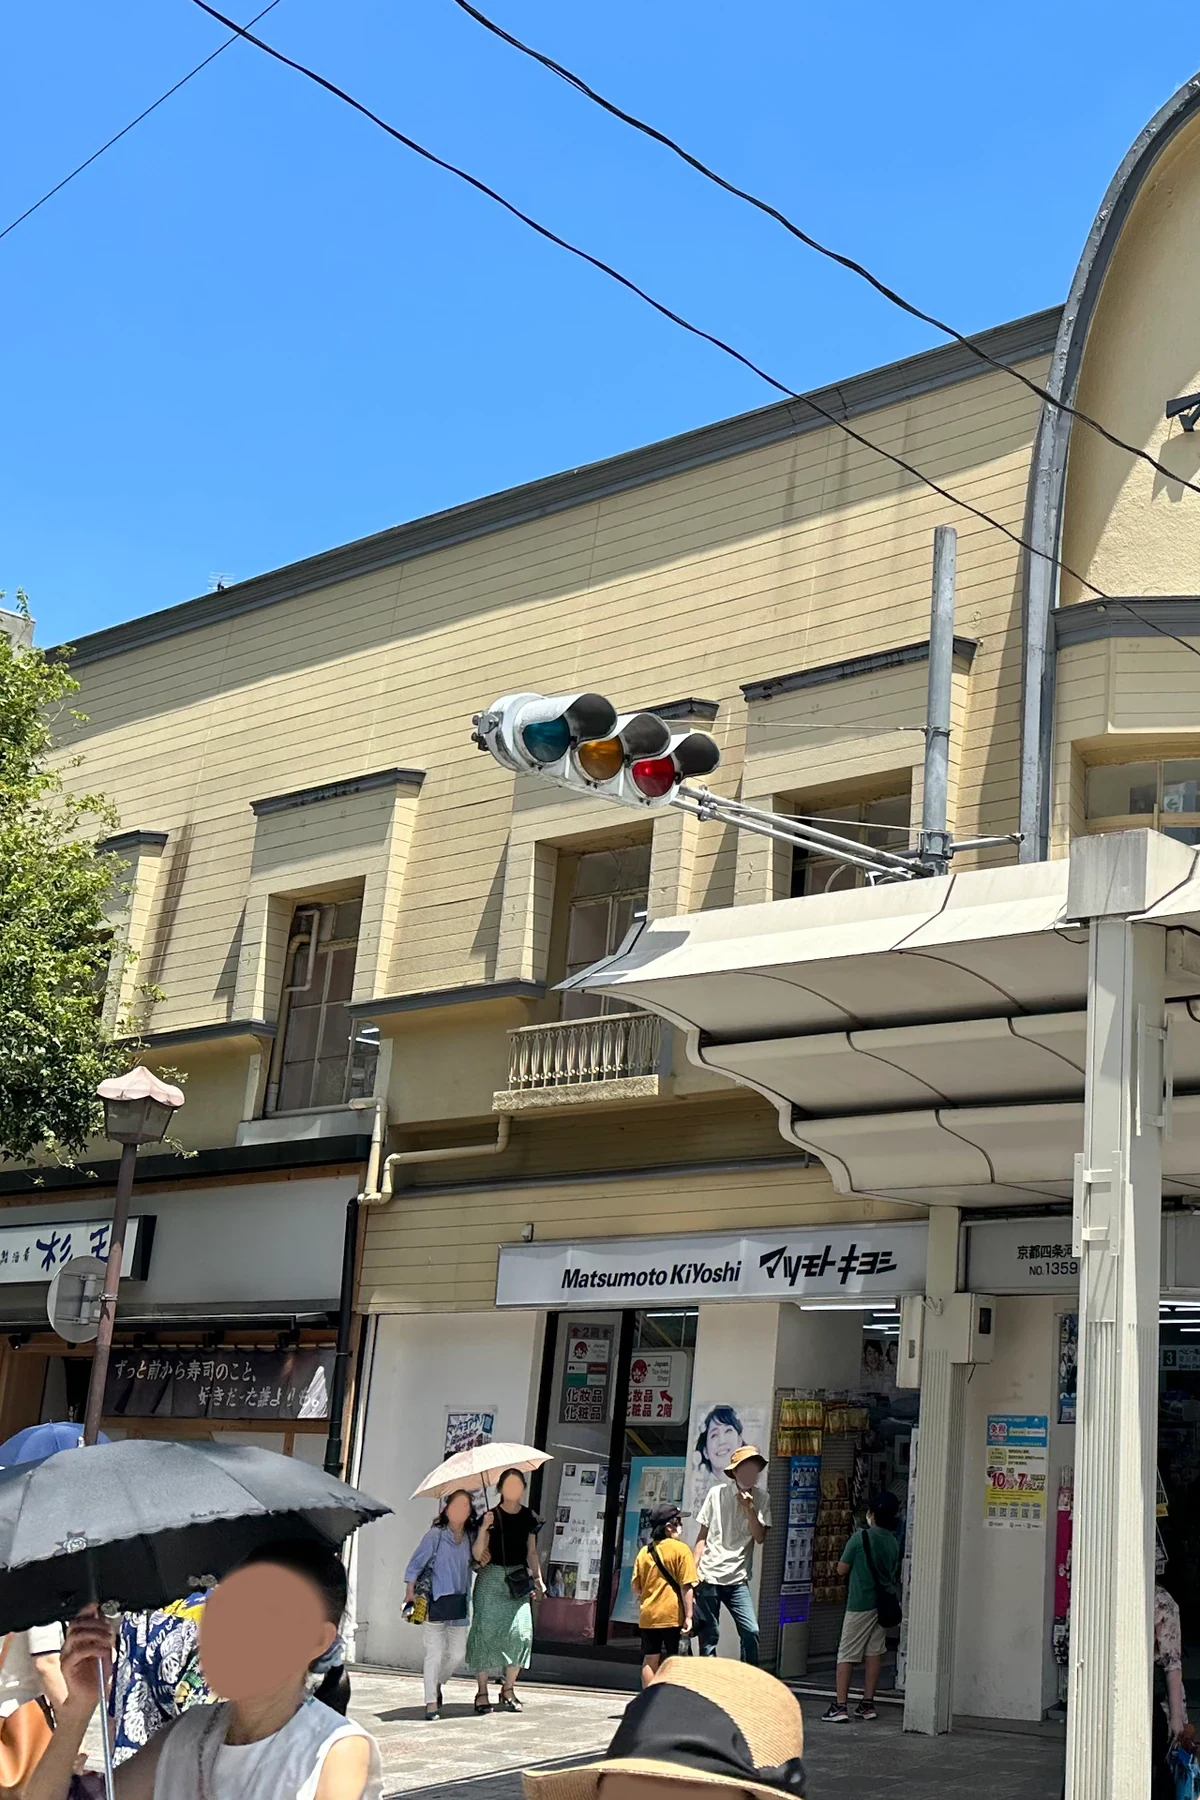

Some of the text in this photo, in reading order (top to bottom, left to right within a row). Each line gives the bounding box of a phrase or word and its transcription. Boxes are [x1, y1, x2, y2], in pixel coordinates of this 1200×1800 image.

[561, 1260, 742, 1288] Matsumoto KiYoshi
[759, 1244, 898, 1286] マツモトキヨシ
[115, 1359, 257, 1383] ずっと前から寿司のこと、
[1166, 1352, 1173, 1365] 3
